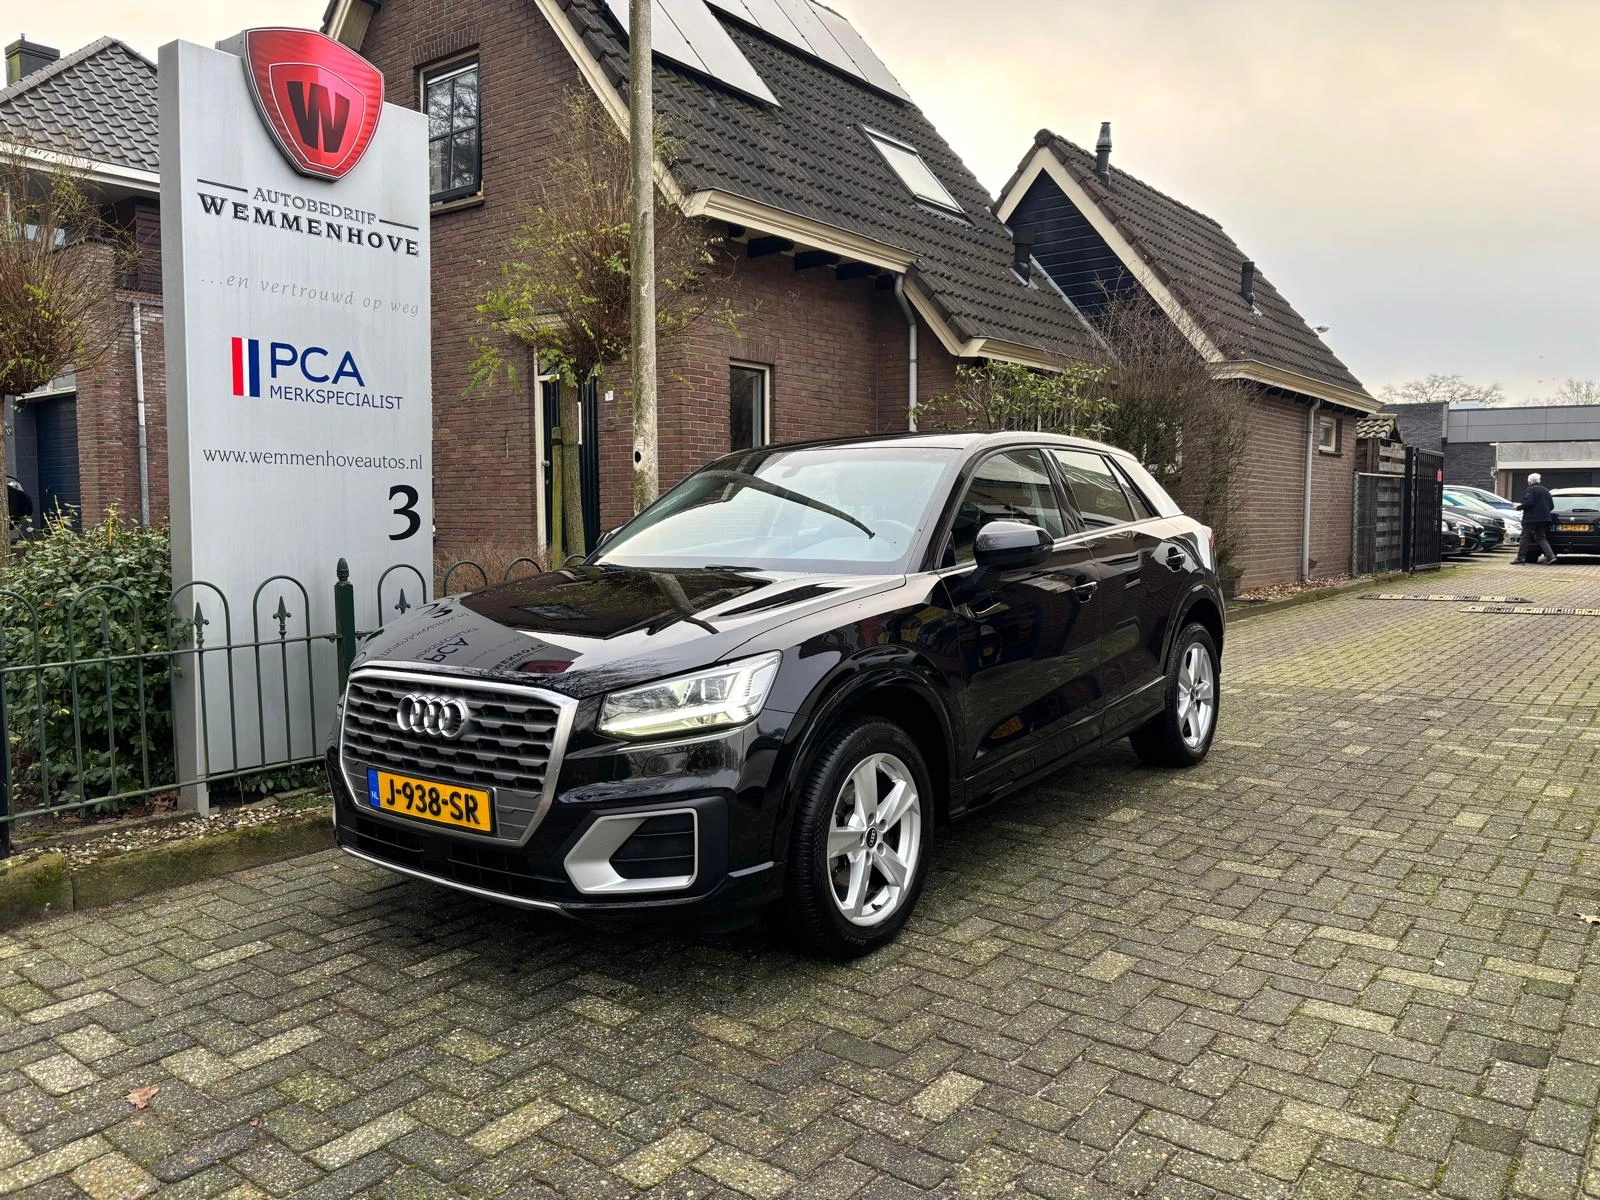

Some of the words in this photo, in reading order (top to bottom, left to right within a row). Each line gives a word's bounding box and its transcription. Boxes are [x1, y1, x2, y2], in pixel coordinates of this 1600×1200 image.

[286, 81, 350, 153] W
[197, 192, 420, 257] WEMMENHOVE
[253, 187, 377, 225] AUTOBEDRIJF
[260, 279, 354, 305] vertrouwd
[363, 297, 382, 311] op
[390, 301, 419, 317] weg
[270, 341, 366, 387] PCA
[270, 385, 403, 410] MERKSPECIALIST
[202, 449, 423, 470] www.wemmenhoveautos.nl
[388, 484, 421, 541] 3
[371, 791, 379, 800] NL
[386, 778, 480, 824] J-938-SR
